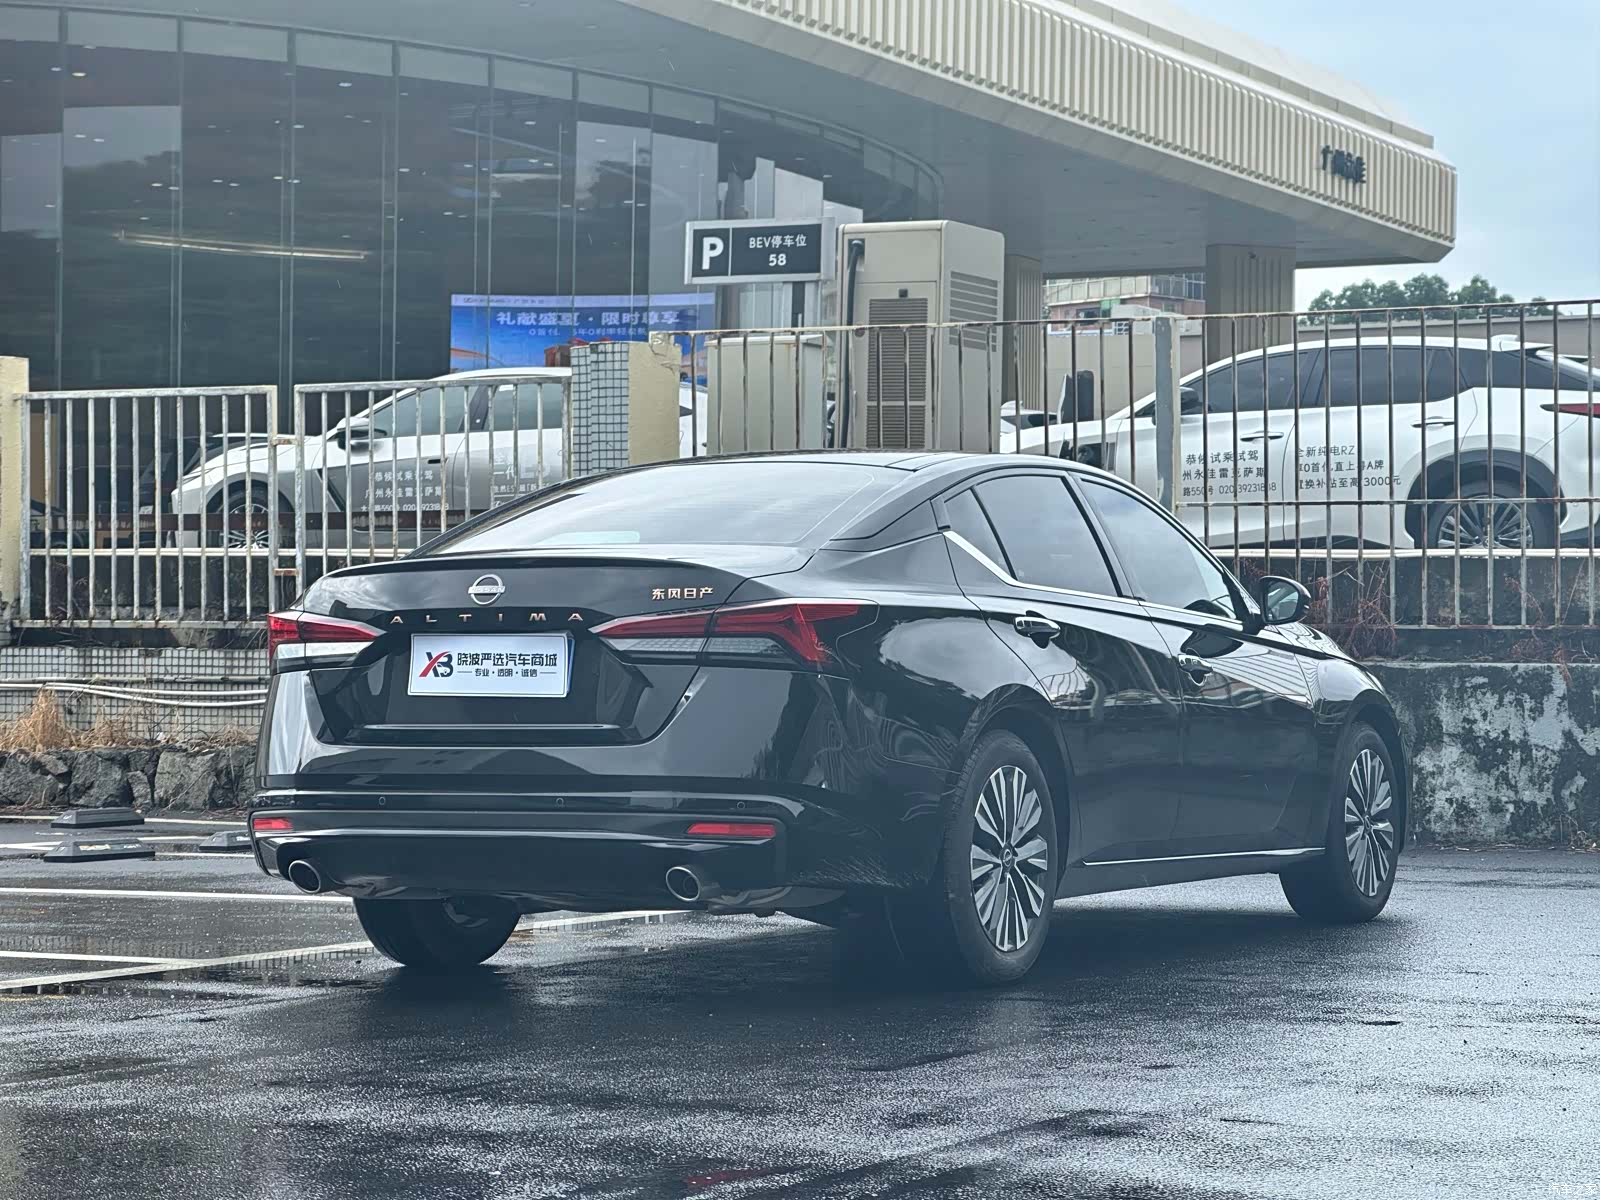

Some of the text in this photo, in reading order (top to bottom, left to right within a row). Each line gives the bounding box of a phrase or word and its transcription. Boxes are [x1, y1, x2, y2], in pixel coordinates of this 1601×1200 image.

[748, 234, 808, 249] BEV停车位
[702, 236, 724, 270] P
[768, 253, 787, 267] 58
[652, 586, 714, 601] 东风日产
[390, 612, 584, 625] ALTIMA
[457, 652, 558, 667] 晓波严选汽车商城
